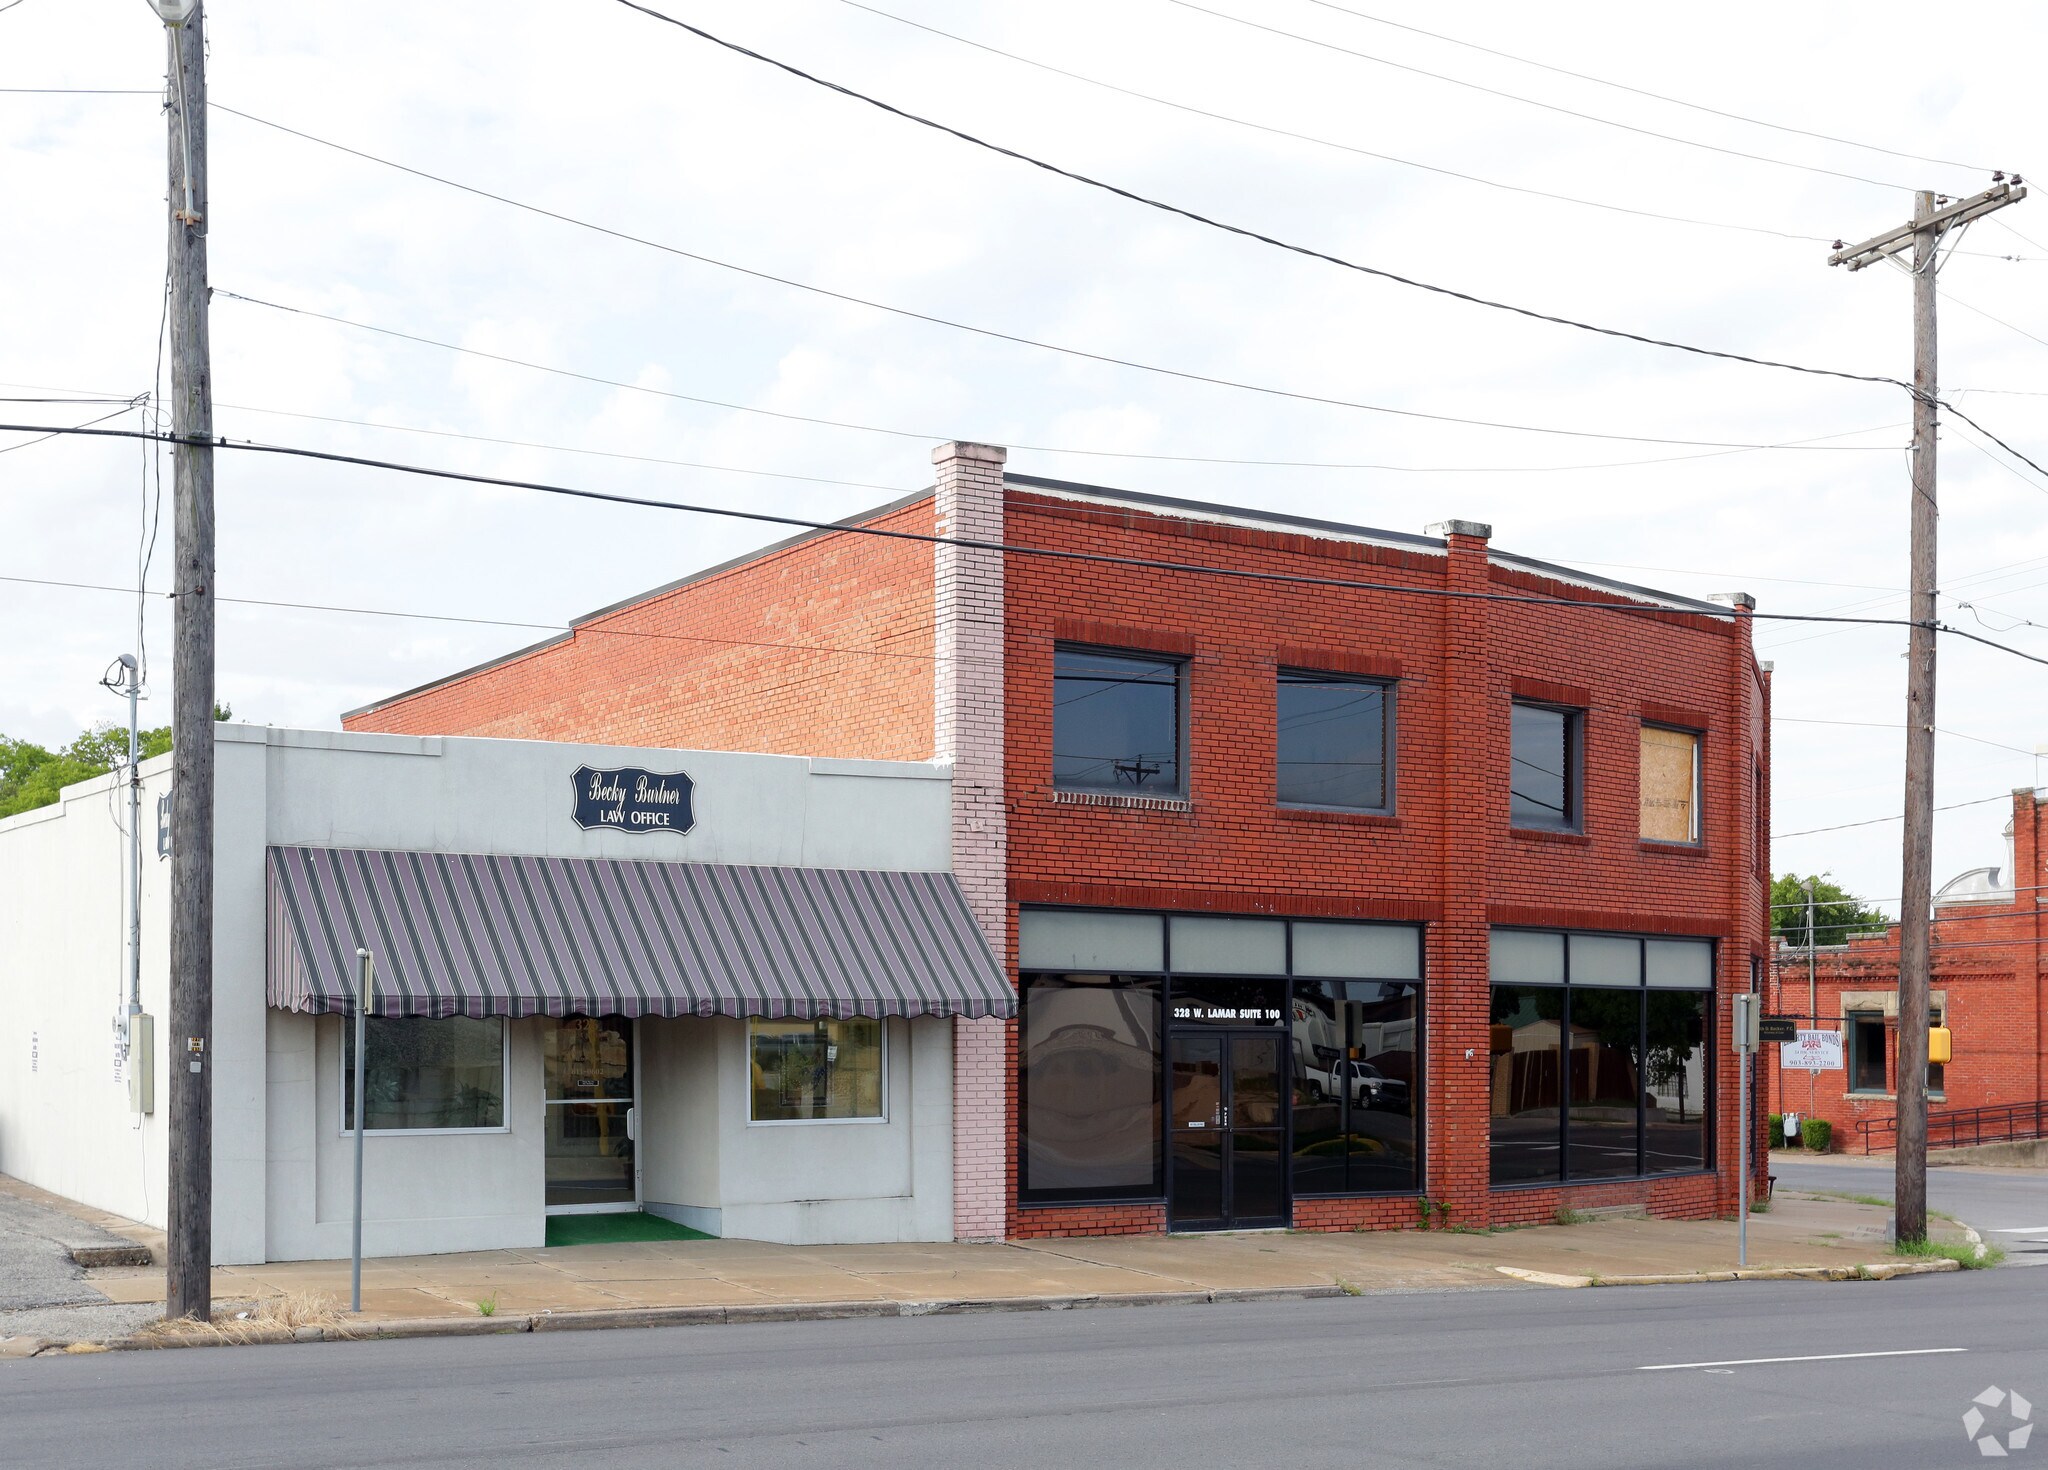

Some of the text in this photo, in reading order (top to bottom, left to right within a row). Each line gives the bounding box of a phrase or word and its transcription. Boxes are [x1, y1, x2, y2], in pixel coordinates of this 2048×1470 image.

[588, 772, 680, 816] Becky Burtner
[600, 809, 670, 826] LAW OFFICE
[1173, 1008, 1281, 1019] 328 W. LAMAR SUITE 100
[1808, 1033, 1820, 1041] BAIL
[1822, 1033, 1840, 1047] BONDS
